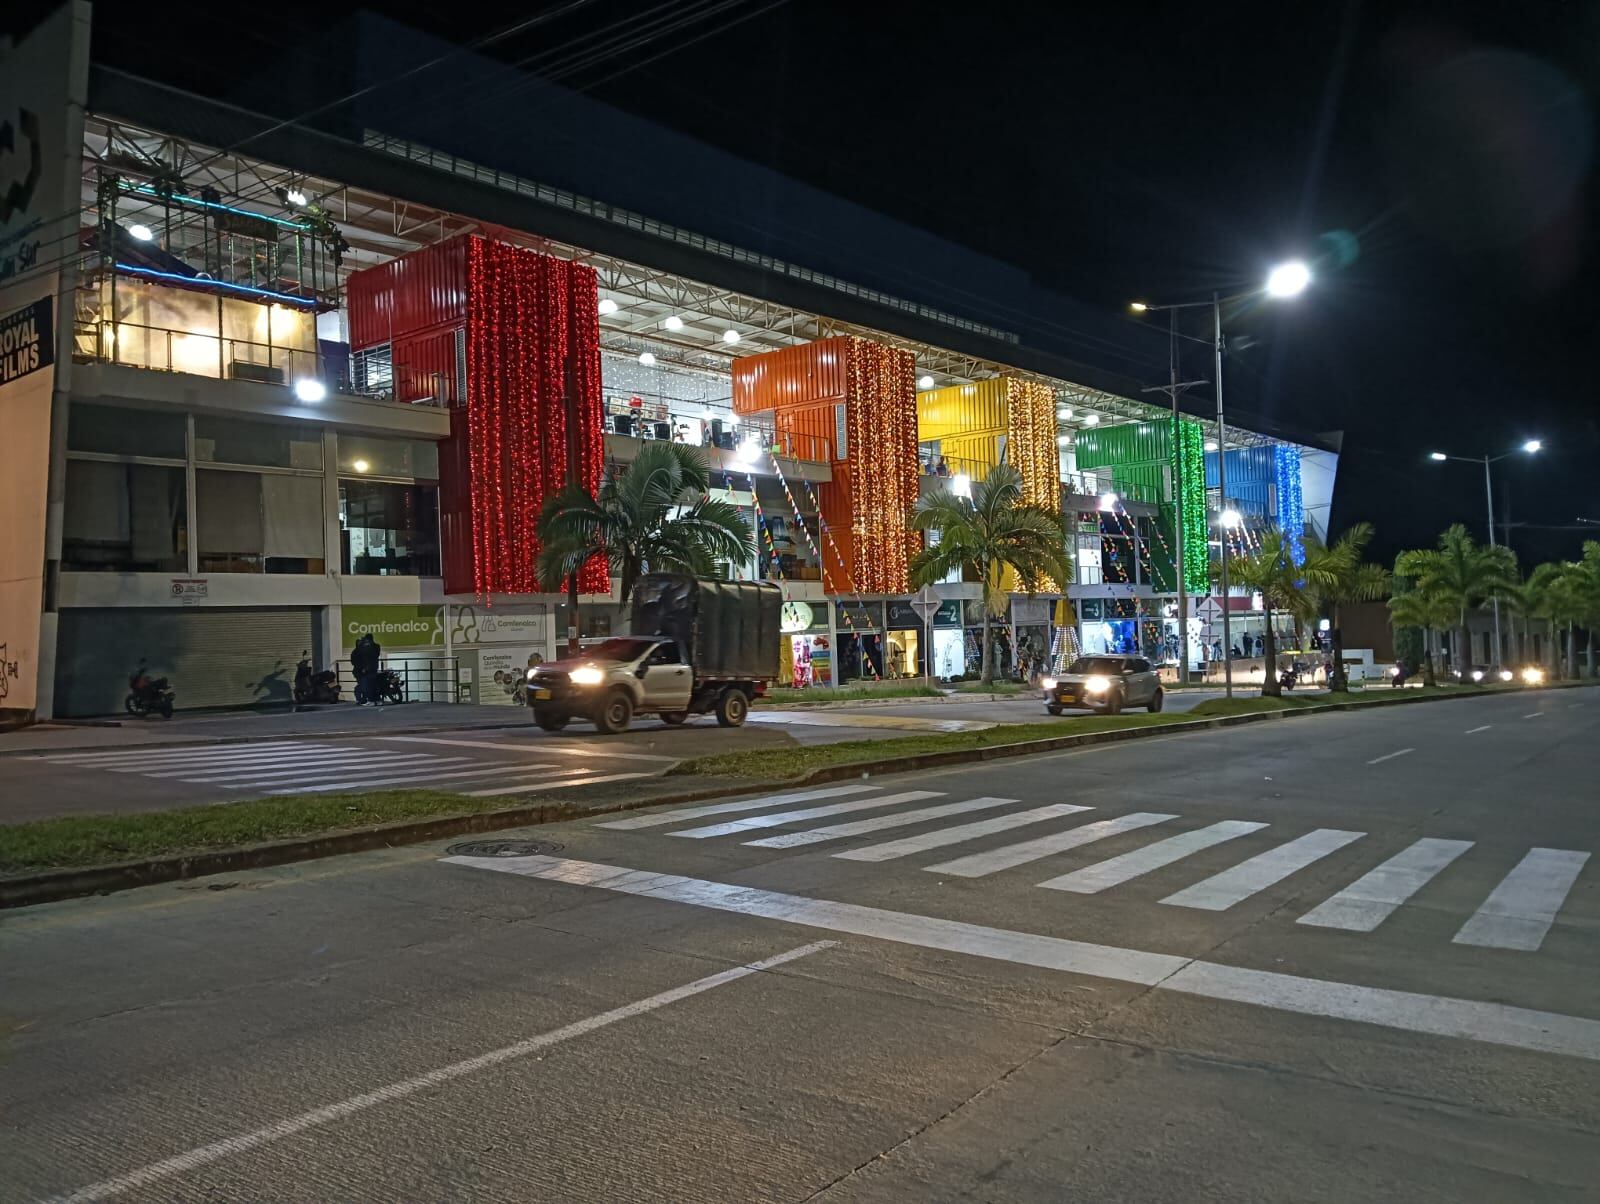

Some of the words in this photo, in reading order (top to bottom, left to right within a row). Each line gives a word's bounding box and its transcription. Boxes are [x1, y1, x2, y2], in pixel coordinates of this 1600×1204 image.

[950, 605, 957, 622] 2
[1093, 602, 1100, 617] 3
[348, 620, 429, 634] Comfenalco
